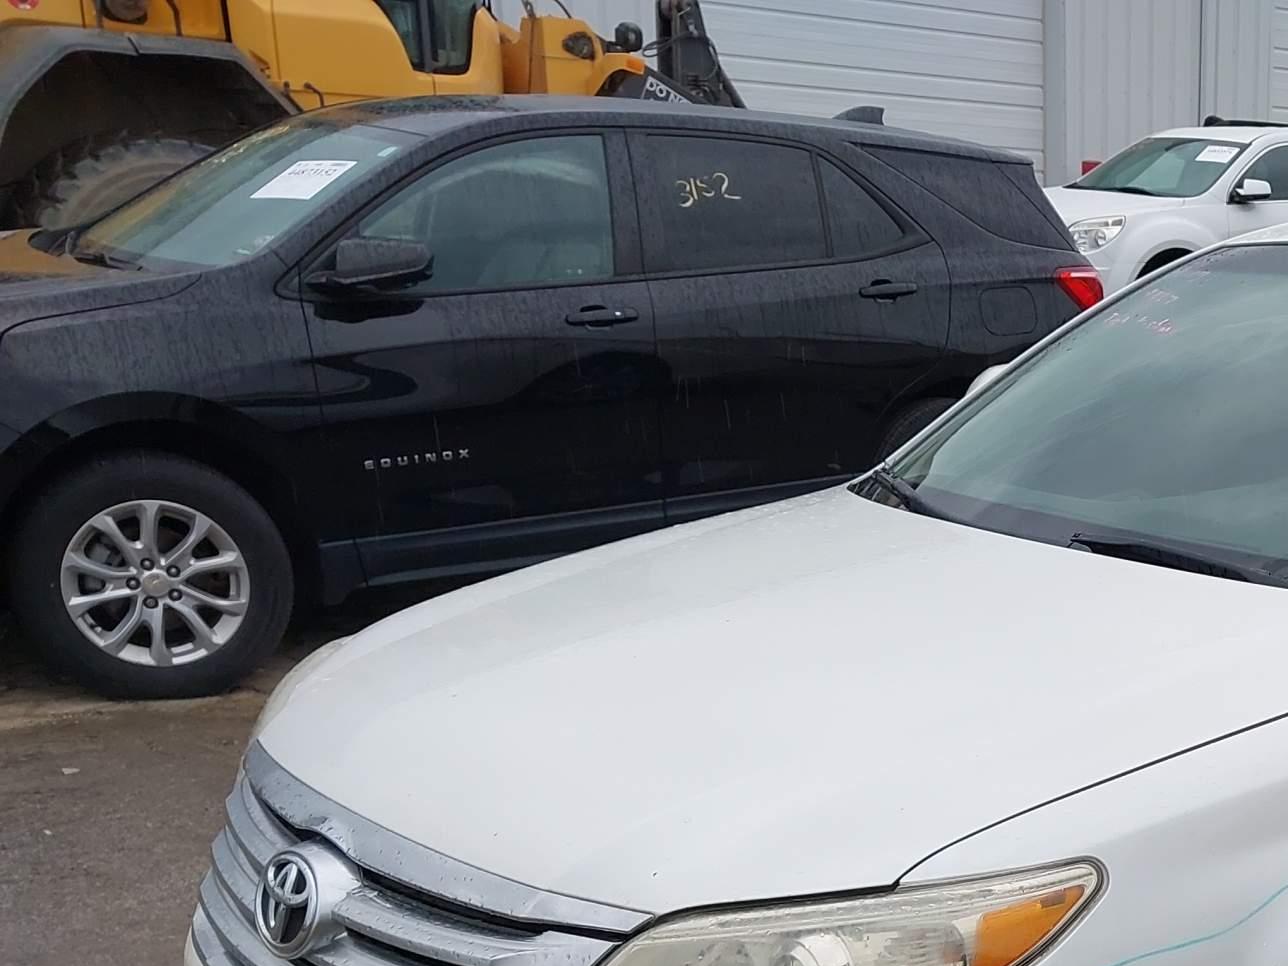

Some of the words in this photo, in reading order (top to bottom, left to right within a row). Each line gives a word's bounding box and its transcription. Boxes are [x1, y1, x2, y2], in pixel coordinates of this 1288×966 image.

[646, 79, 667, 98] DO
[675, 172, 742, 208] 3152
[363, 448, 470, 470] EQUINOX
